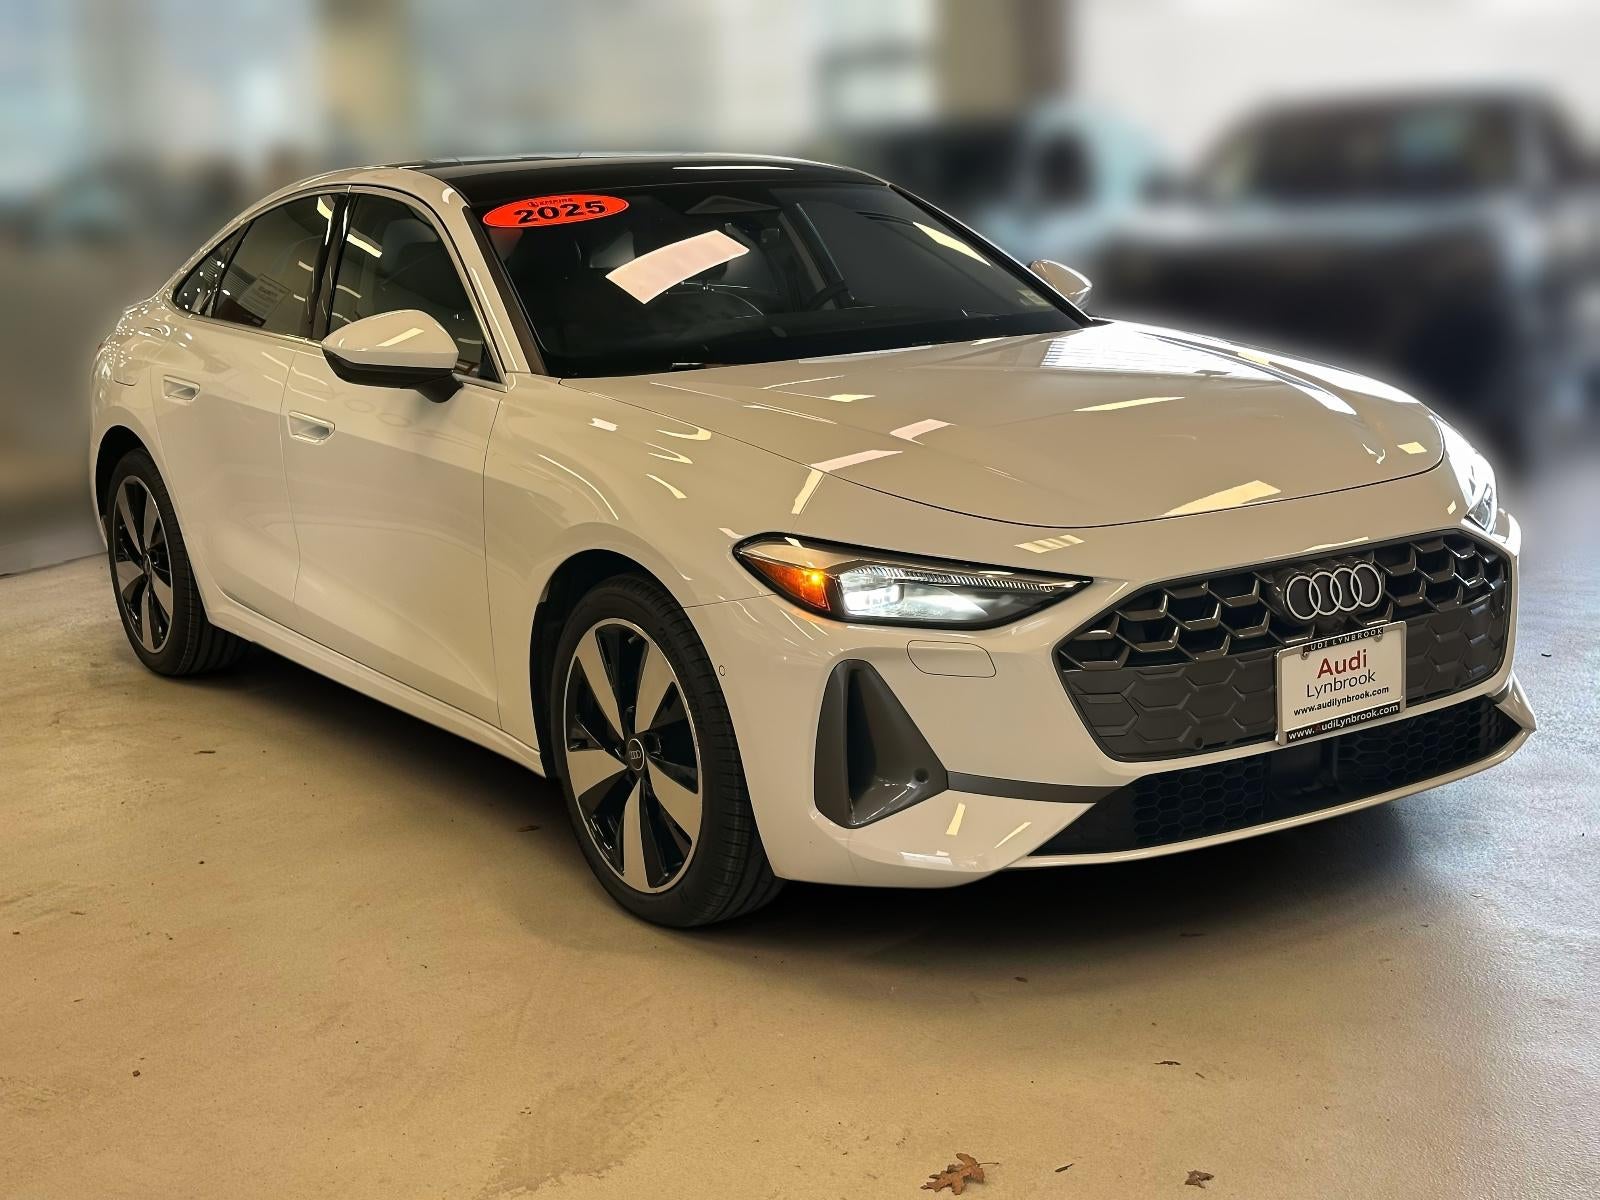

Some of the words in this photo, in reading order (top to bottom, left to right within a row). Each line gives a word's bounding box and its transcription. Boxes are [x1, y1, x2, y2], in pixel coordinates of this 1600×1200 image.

[514, 200, 606, 224] 2025
[1332, 627, 1383, 645] LYNBROOK
[1316, 648, 1367, 679] Audi
[1306, 669, 1376, 699] Lynbrook
[1293, 686, 1390, 716] www.audilynbrook.com
[1288, 704, 1399, 740] www.AudiLynbrook.com
